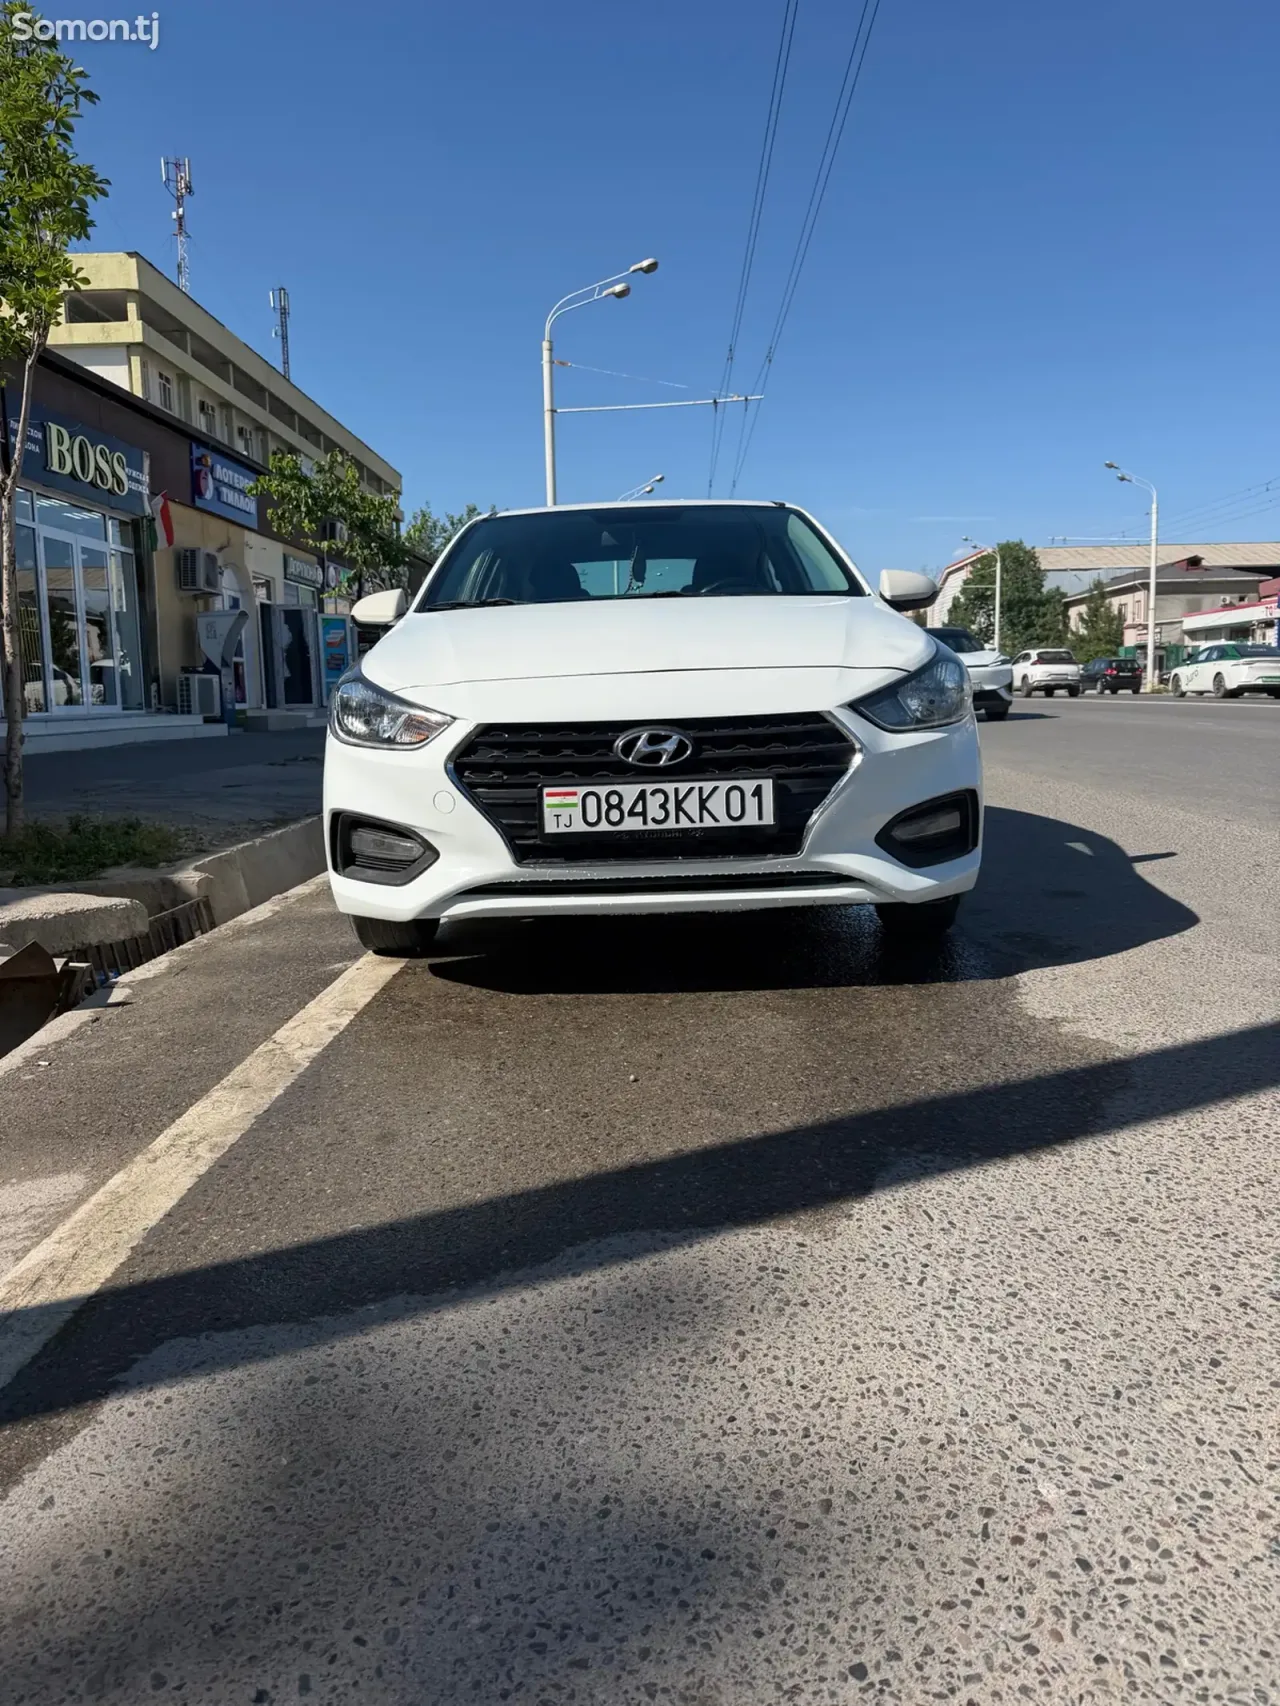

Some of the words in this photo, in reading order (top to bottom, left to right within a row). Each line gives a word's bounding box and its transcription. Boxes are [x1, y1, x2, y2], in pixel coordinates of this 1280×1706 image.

[46, 421, 129, 496] BOSS
[553, 814, 573, 828] TJ
[581, 784, 764, 827] 0843KK01
